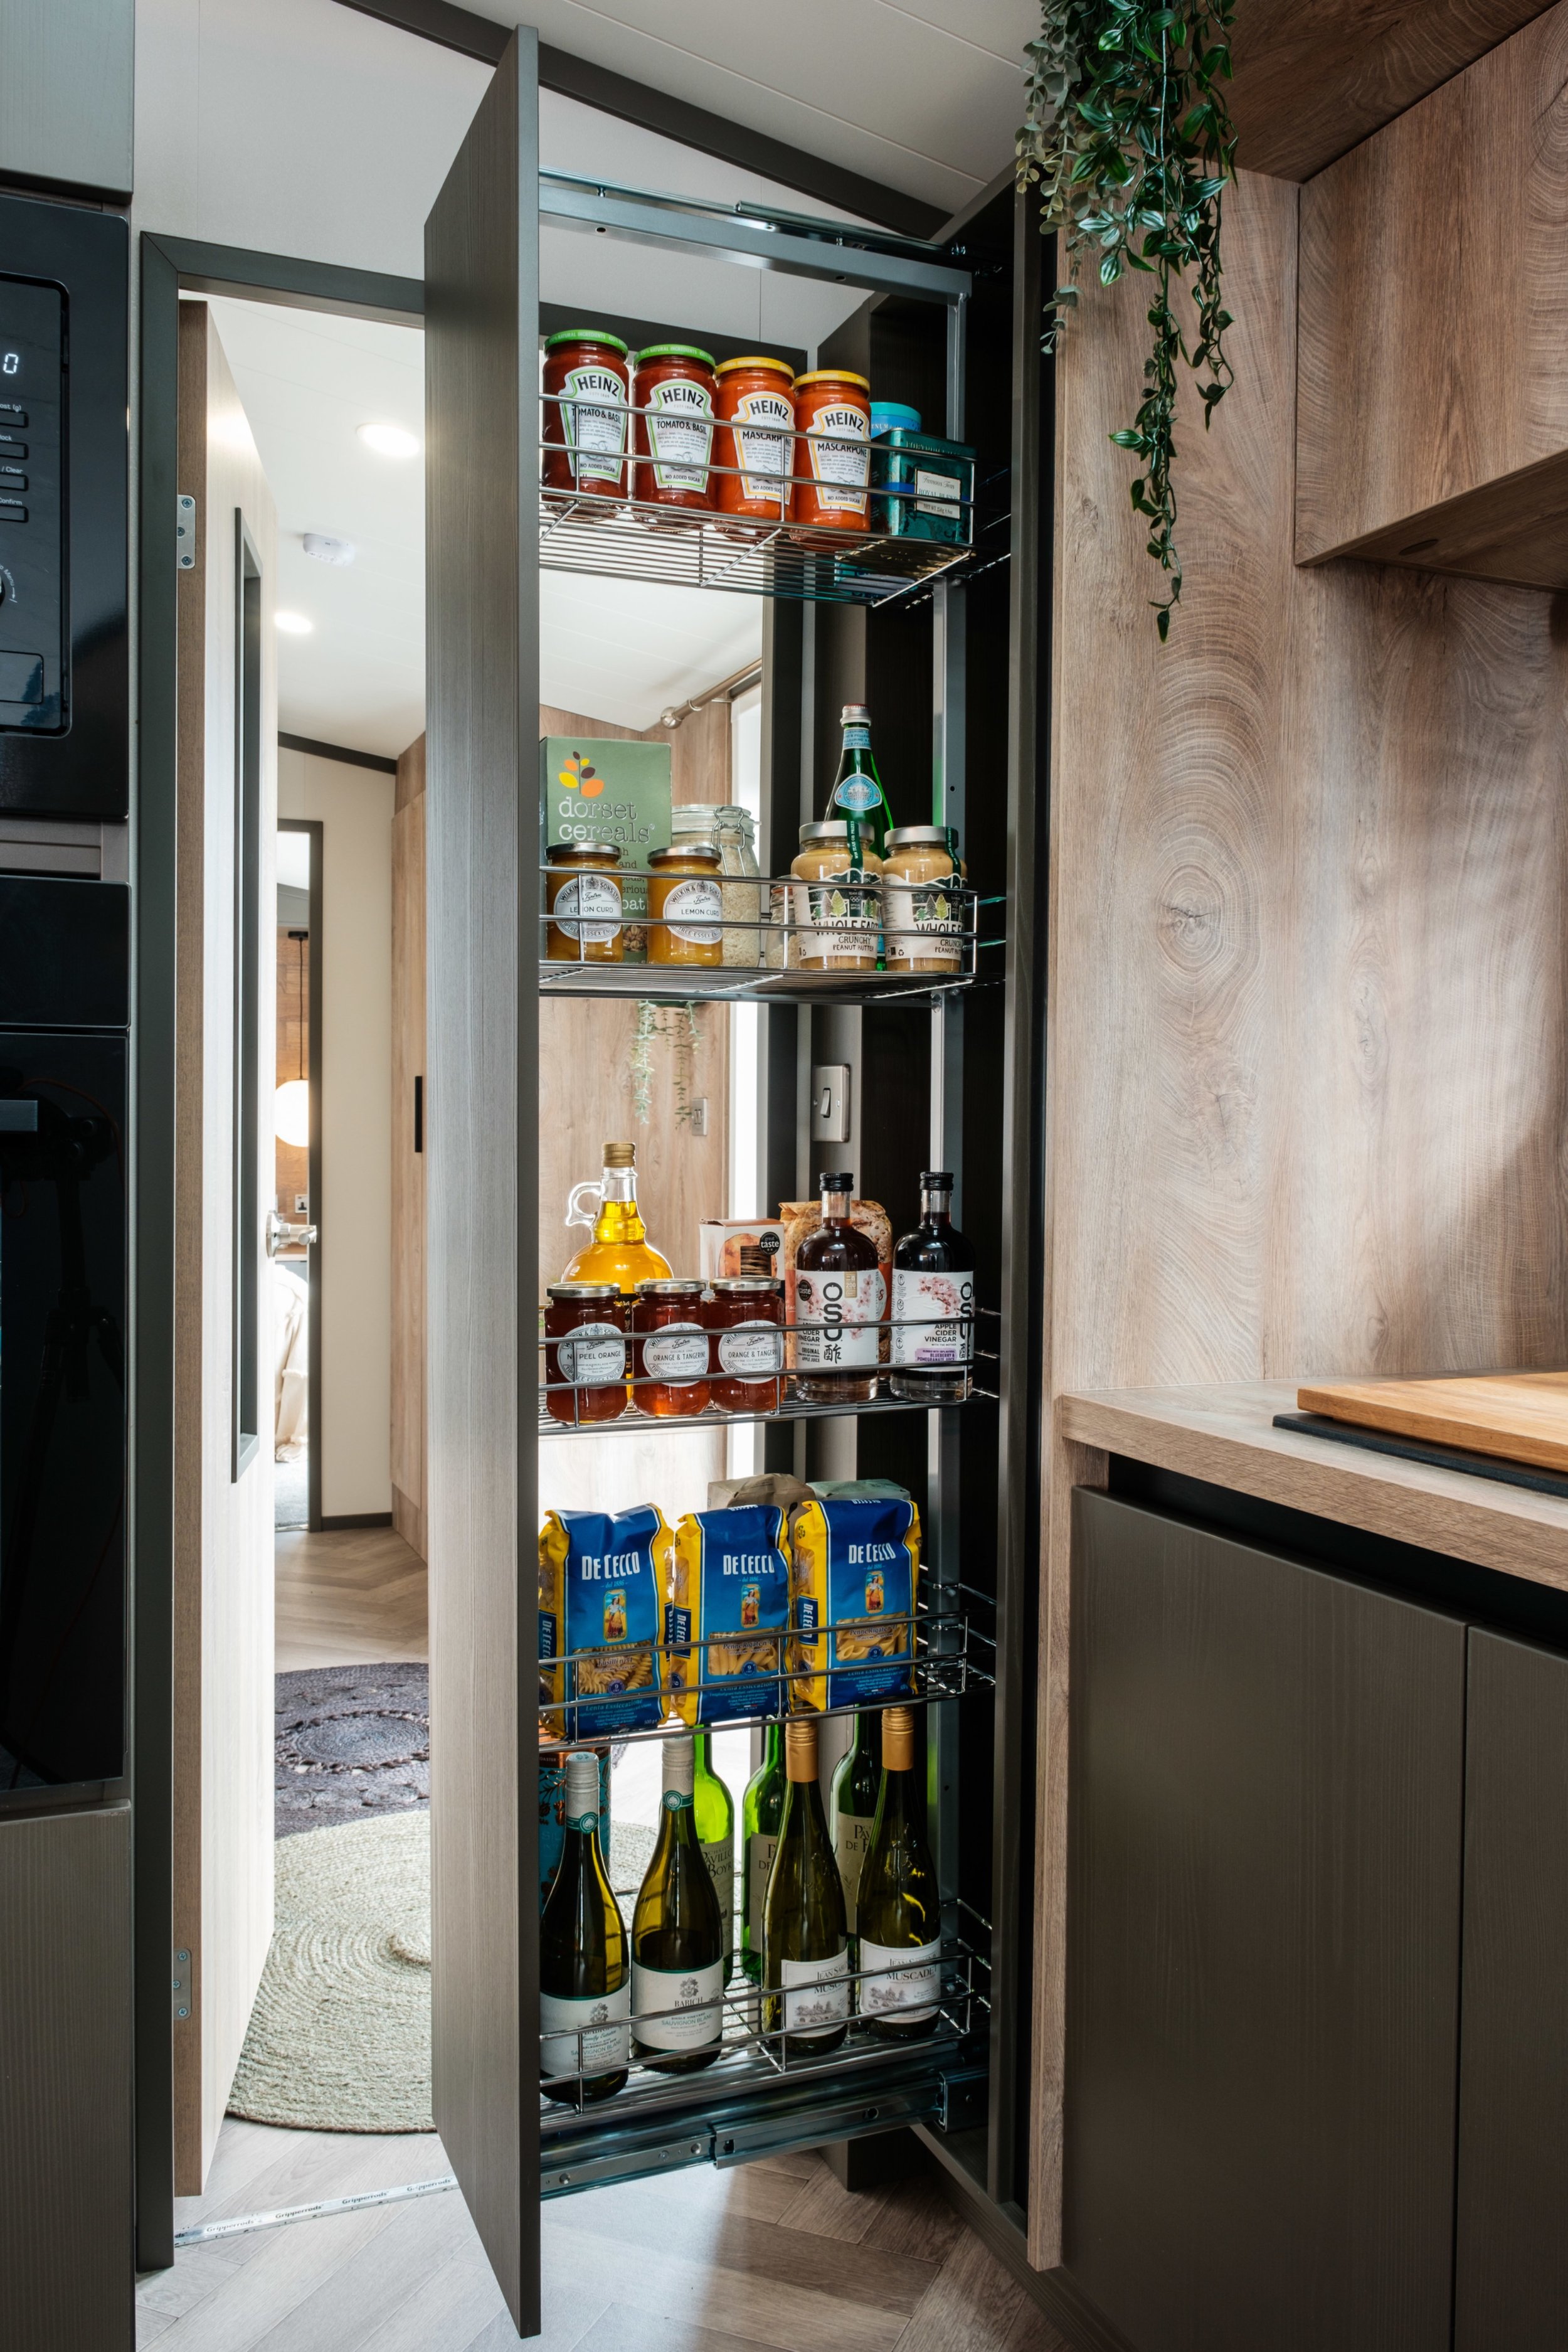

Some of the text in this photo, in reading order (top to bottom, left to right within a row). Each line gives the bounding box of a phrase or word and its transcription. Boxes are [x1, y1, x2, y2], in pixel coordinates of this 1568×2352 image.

[670, 346, 697, 354] INGREDIENTS
[3, 353, 19, 373] 0
[577, 375, 619, 396] HEINZ
[662, 388, 704, 408] HEINZ
[13, 404, 21, 413] (g)
[750, 400, 788, 421] HEINZ
[608, 412, 622, 424] BASIL
[825, 412, 864, 432] HEINZ
[657, 420, 707, 434] TOMATO & BASIL
[743, 430, 792, 447] MASCARPNE
[818, 442, 867, 457] MASCARPONE
[6, 466, 23, 474] Clear
[922, 476, 955, 489] Famous Teas
[4, 569, 15, 586] Menu
[558, 796, 638, 821] dorset
[558, 822, 650, 844] cereals
[619, 860, 637, 869] and
[671, 886, 691, 903] WILKIN
[838, 936, 872, 945] CRUNCHY
[940, 939, 963, 947] CRUNCH
[935, 946, 955, 954] PEANUT
[798, 1334, 820, 1343] VINEGAR
[598, 1351, 621, 1359] ORANGE
[682, 1351, 706, 1360] TANGERINE
[849, 1543, 896, 1564] DE CECCO
[582, 1551, 640, 1580] DE CECCO
[723, 1554, 775, 1575] DE CECCO
[586, 1703, 603, 1711] Lenta
[845, 1841, 858, 1851] DE
[708, 1861, 733, 1878] BOYR
[886, 1964, 937, 1981] MUSCADET
[661, 2012, 713, 2026] SAUVIGNON BLANC
[571, 2040, 622, 2056] SAVIGNON BLANC
[342, 2191, 388, 2204] Gripperrods
[275, 2205, 322, 2219] Gripperrods
[206, 2220, 254, 2233] Gripperrods
